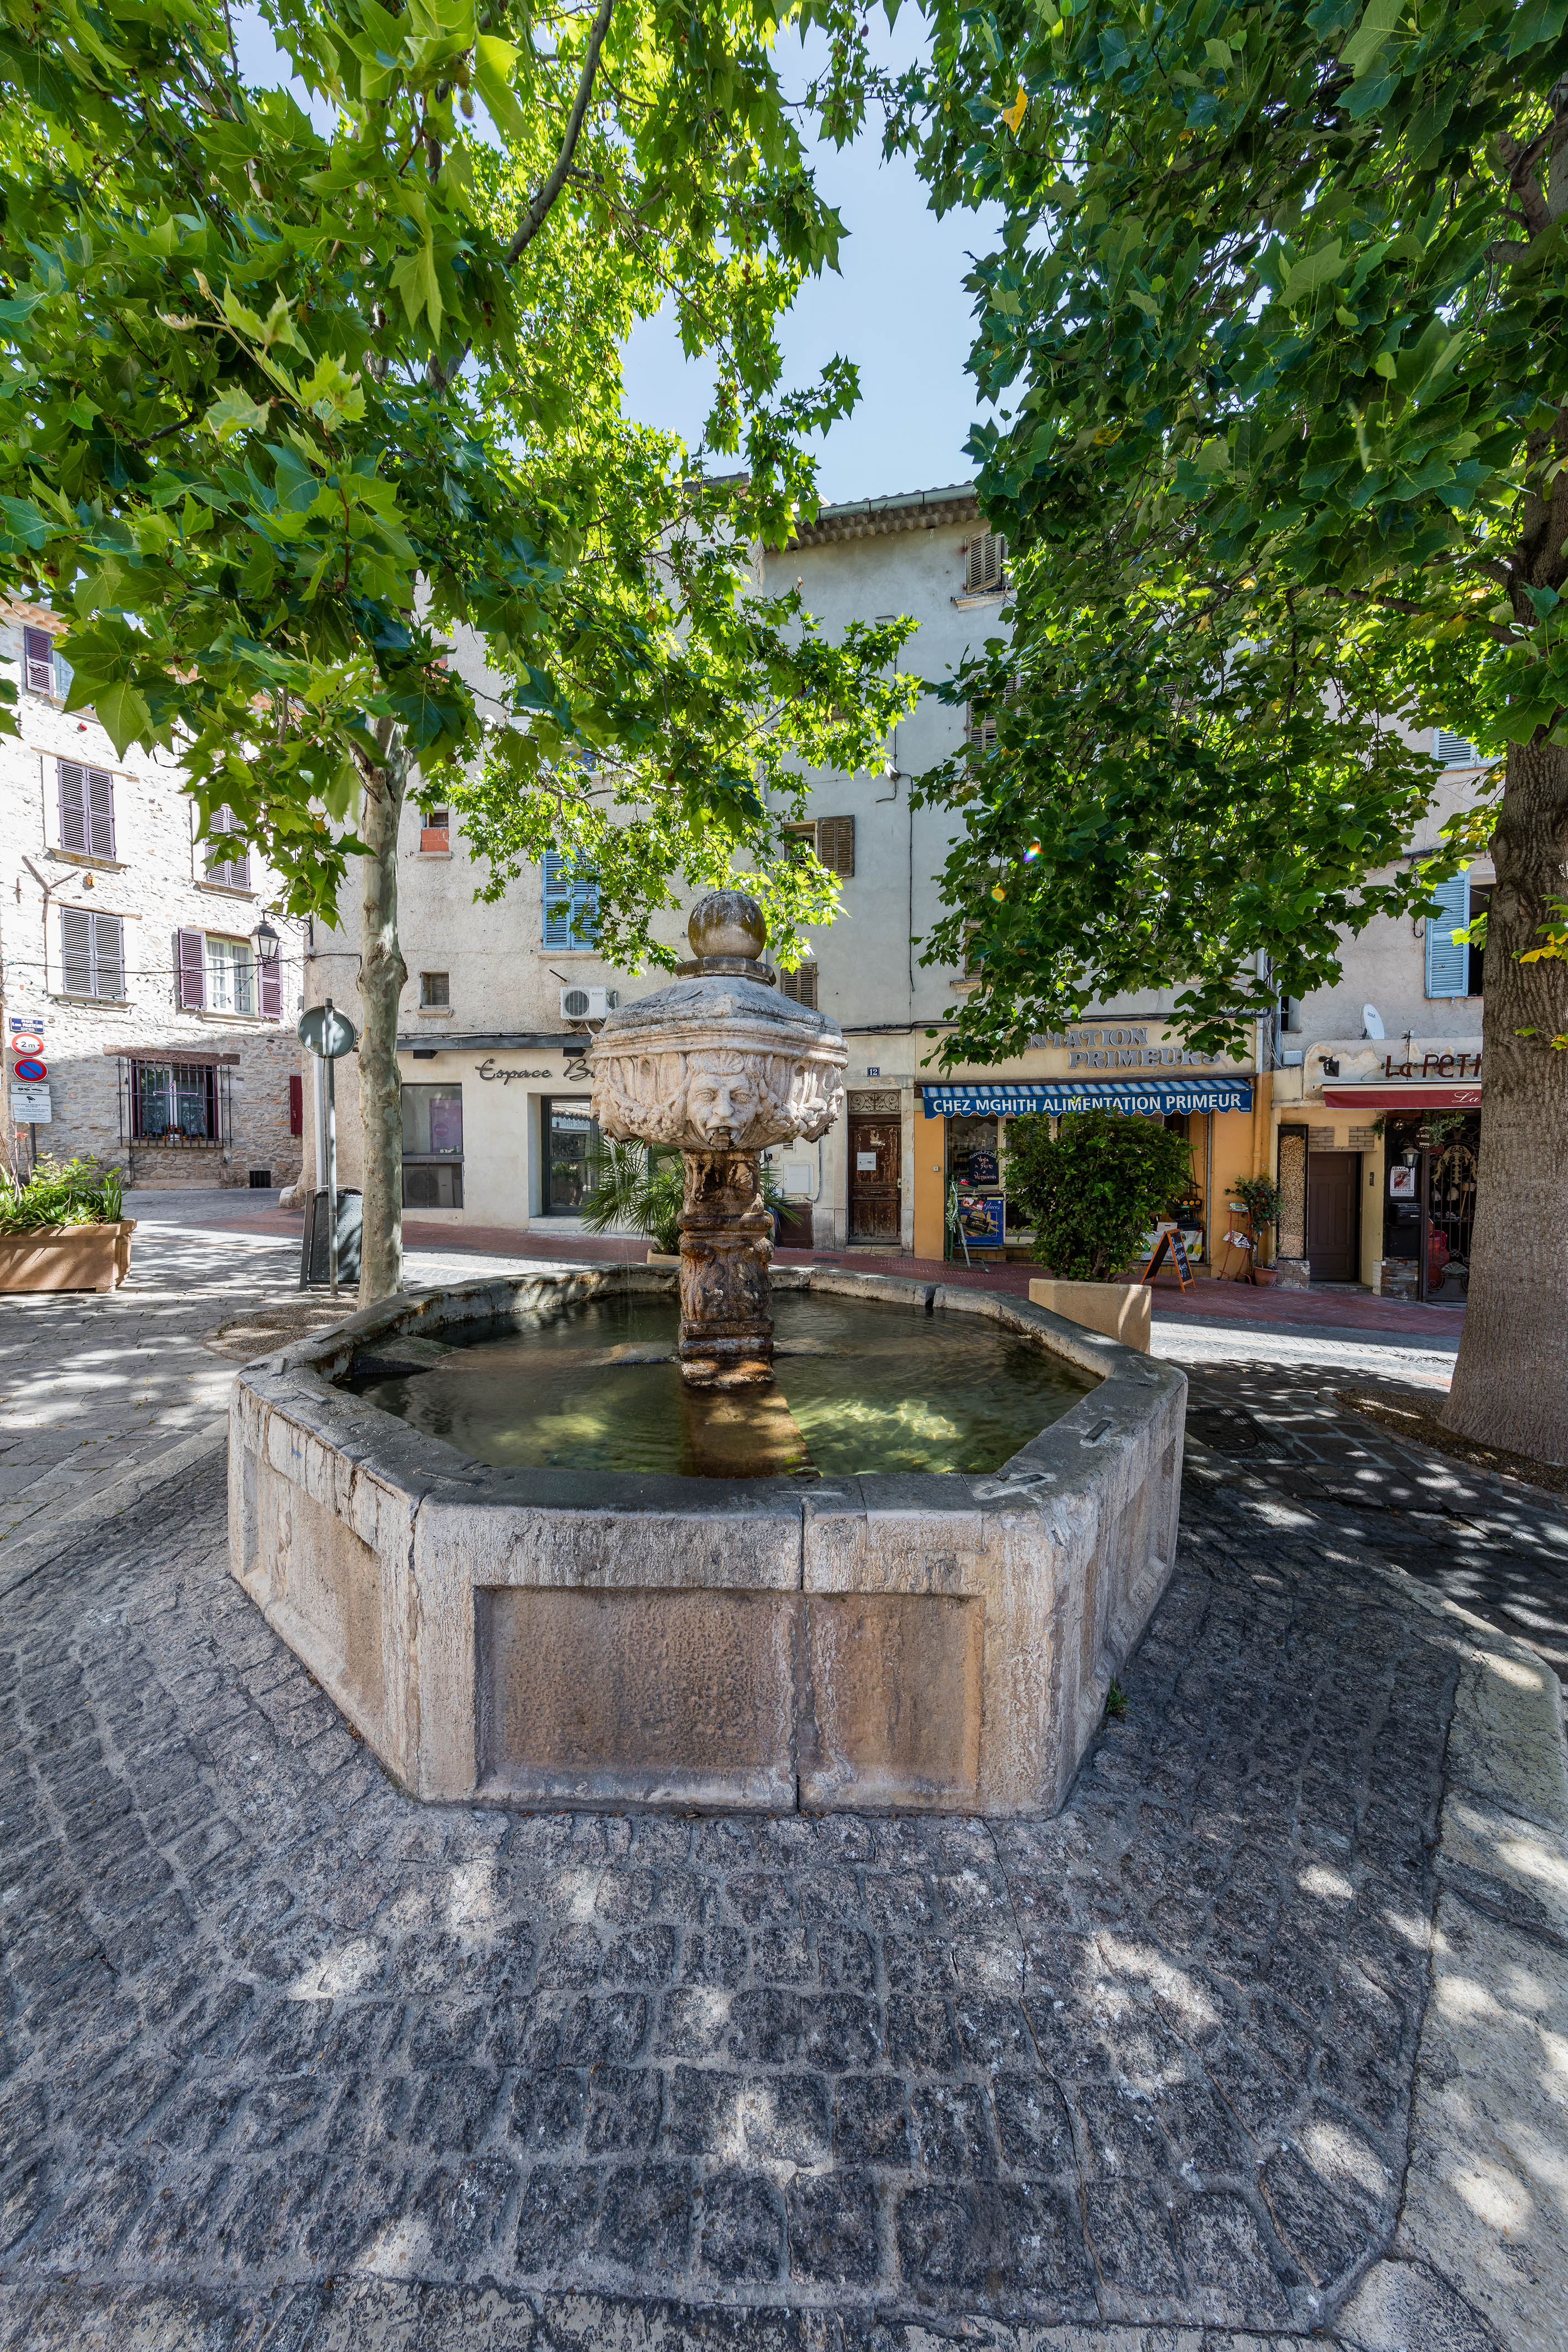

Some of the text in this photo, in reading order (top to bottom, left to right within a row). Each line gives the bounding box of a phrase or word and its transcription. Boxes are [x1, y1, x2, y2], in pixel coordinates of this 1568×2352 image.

[1024, 1027, 1149, 1049] NTATION
[1068, 1047, 1221, 1069] PRIMEURS
[475, 1058, 551, 1086] Espace
[933, 1093, 1241, 1112] CHEZ MGHITH ALIMENTATION PRIMEUR
[1451, 1091, 1480, 1103] La
